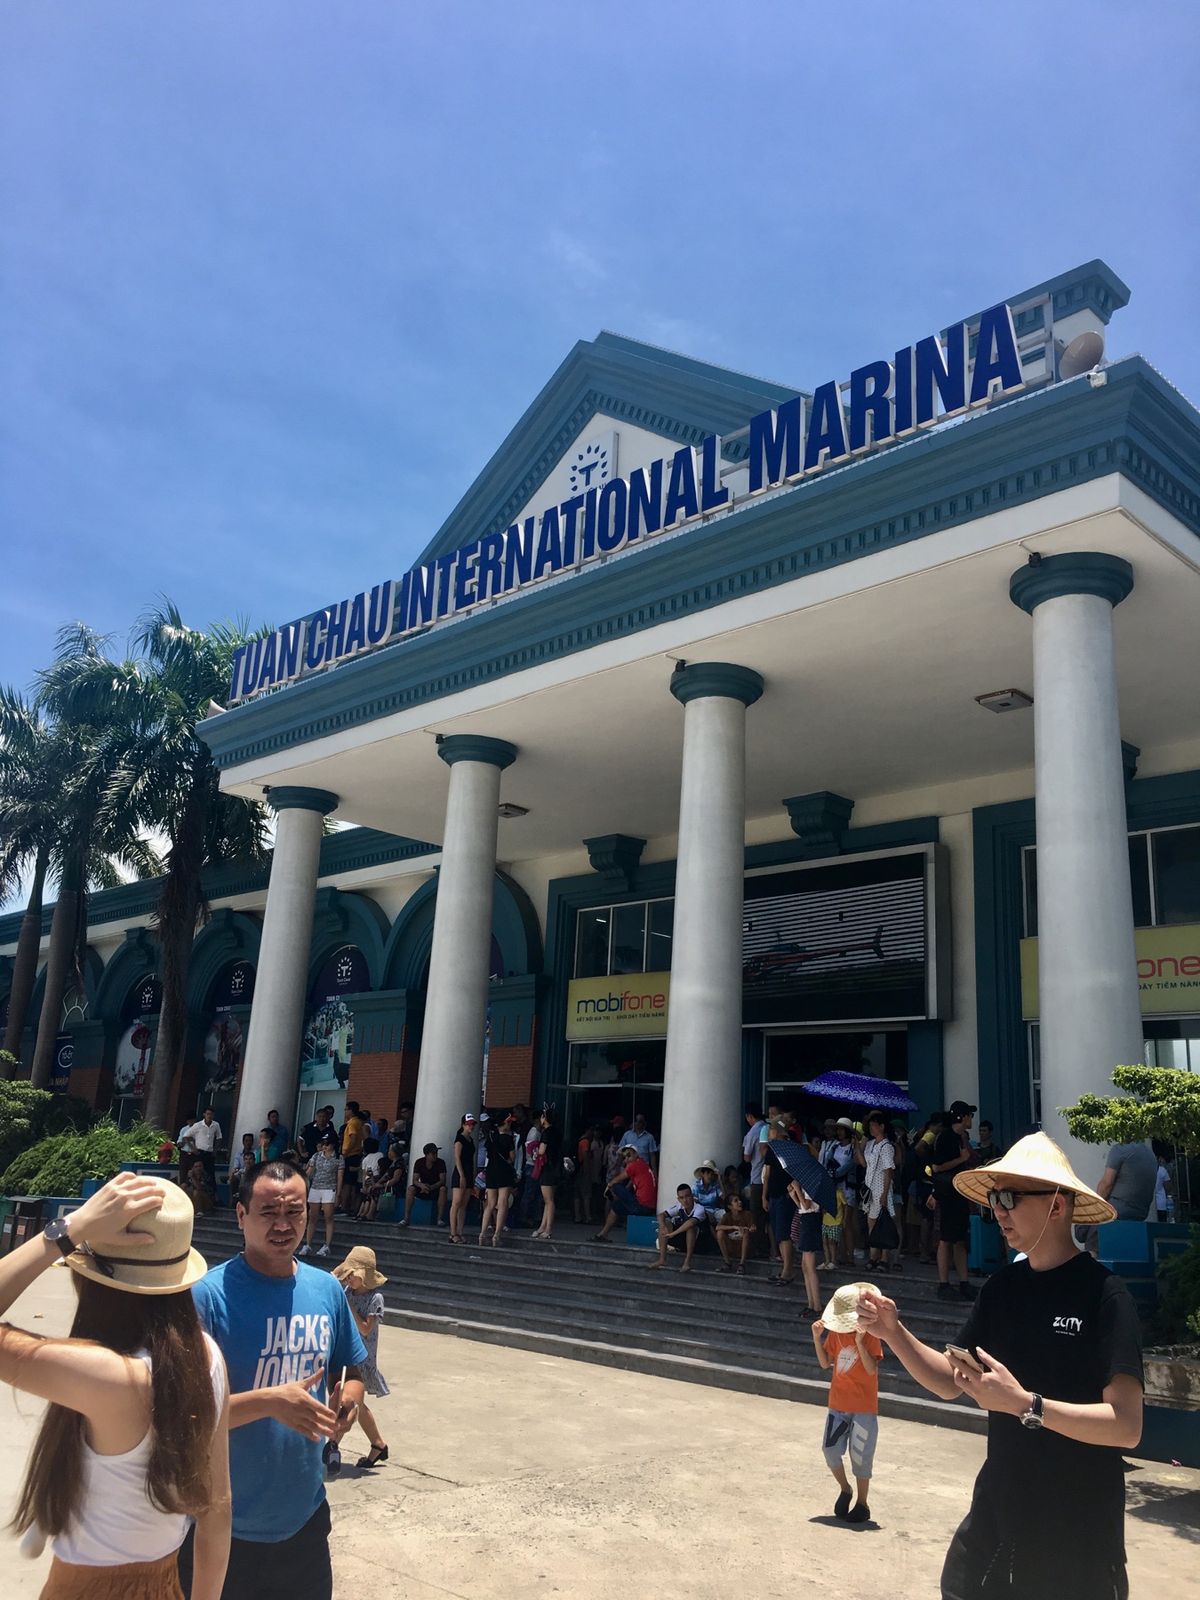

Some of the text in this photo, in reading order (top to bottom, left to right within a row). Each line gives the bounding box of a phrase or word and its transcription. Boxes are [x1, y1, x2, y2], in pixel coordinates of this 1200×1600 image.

[229, 304, 1025, 700] TUAN CHAU INTERNATIONAL MARINA
[577, 991, 666, 1014] mobifone
